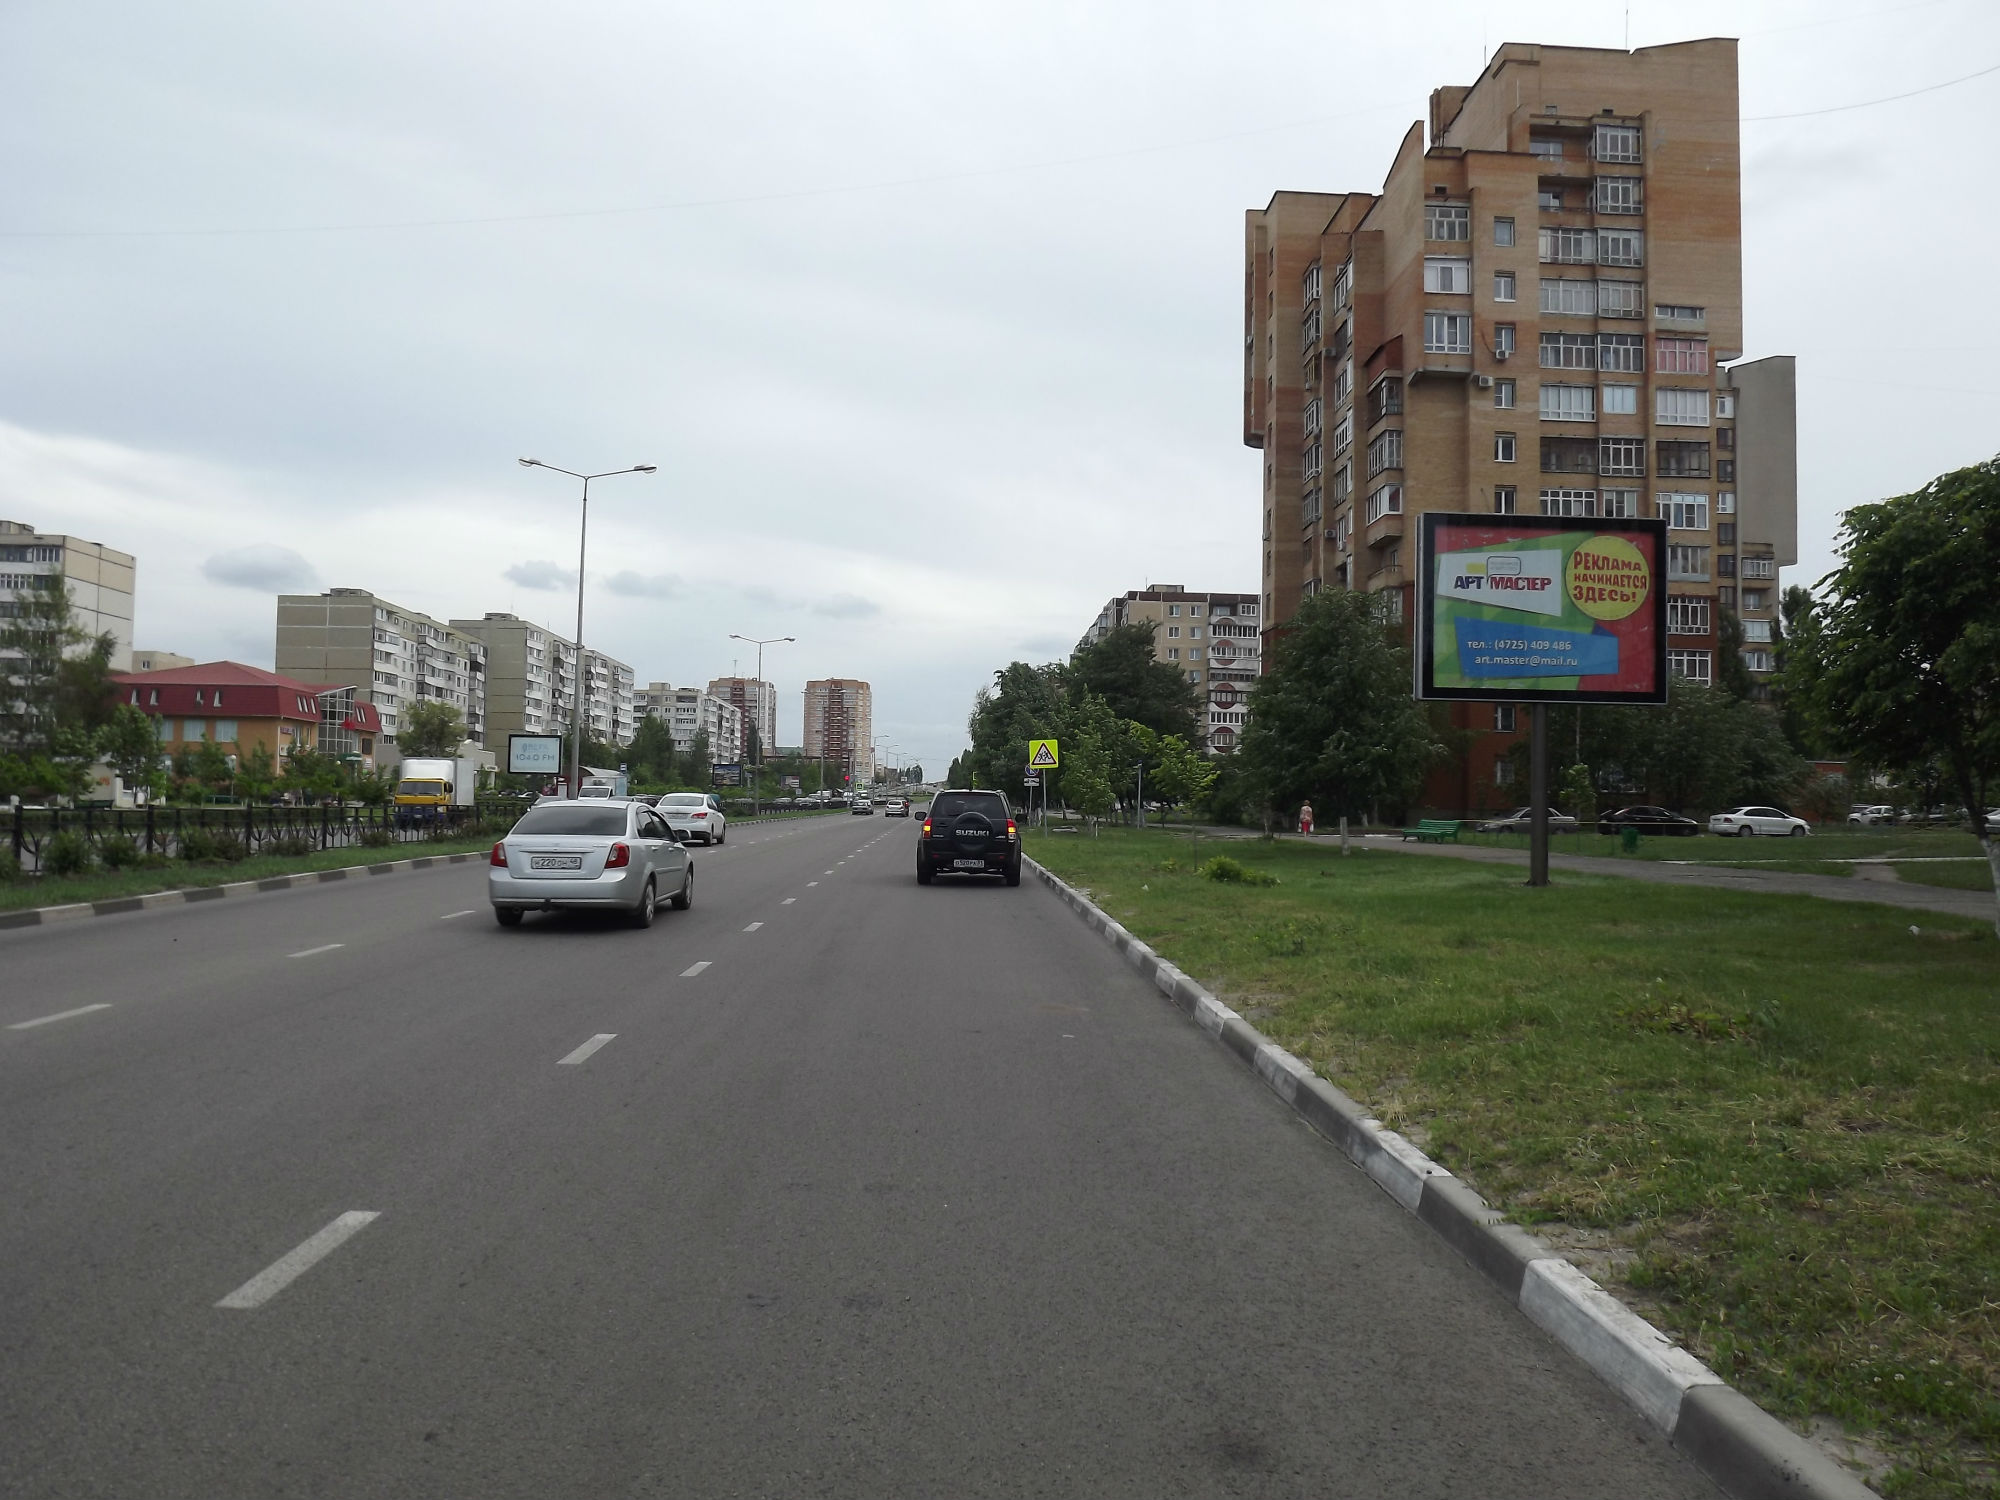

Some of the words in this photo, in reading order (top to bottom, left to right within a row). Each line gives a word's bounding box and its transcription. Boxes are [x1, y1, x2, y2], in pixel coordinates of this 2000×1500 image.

[1573, 550, 1642, 571] РЕКЛАМА
[1453, 575, 1485, 590] АРТ
[1490, 576, 1552, 591] МАСТЕР
[1574, 572, 1648, 590] НАЧИНАЕТСЯ
[1573, 585, 1637, 603] ЗДЕСЬ!
[1467, 641, 1492, 649] тел.:
[1494, 639, 1528, 651] (4725)
[1530, 640, 1549, 650] 409
[1552, 641, 1572, 651] 486
[1474, 655, 1578, 667] art.master@mail.ru
[955, 829, 990, 837] SUZUKI
